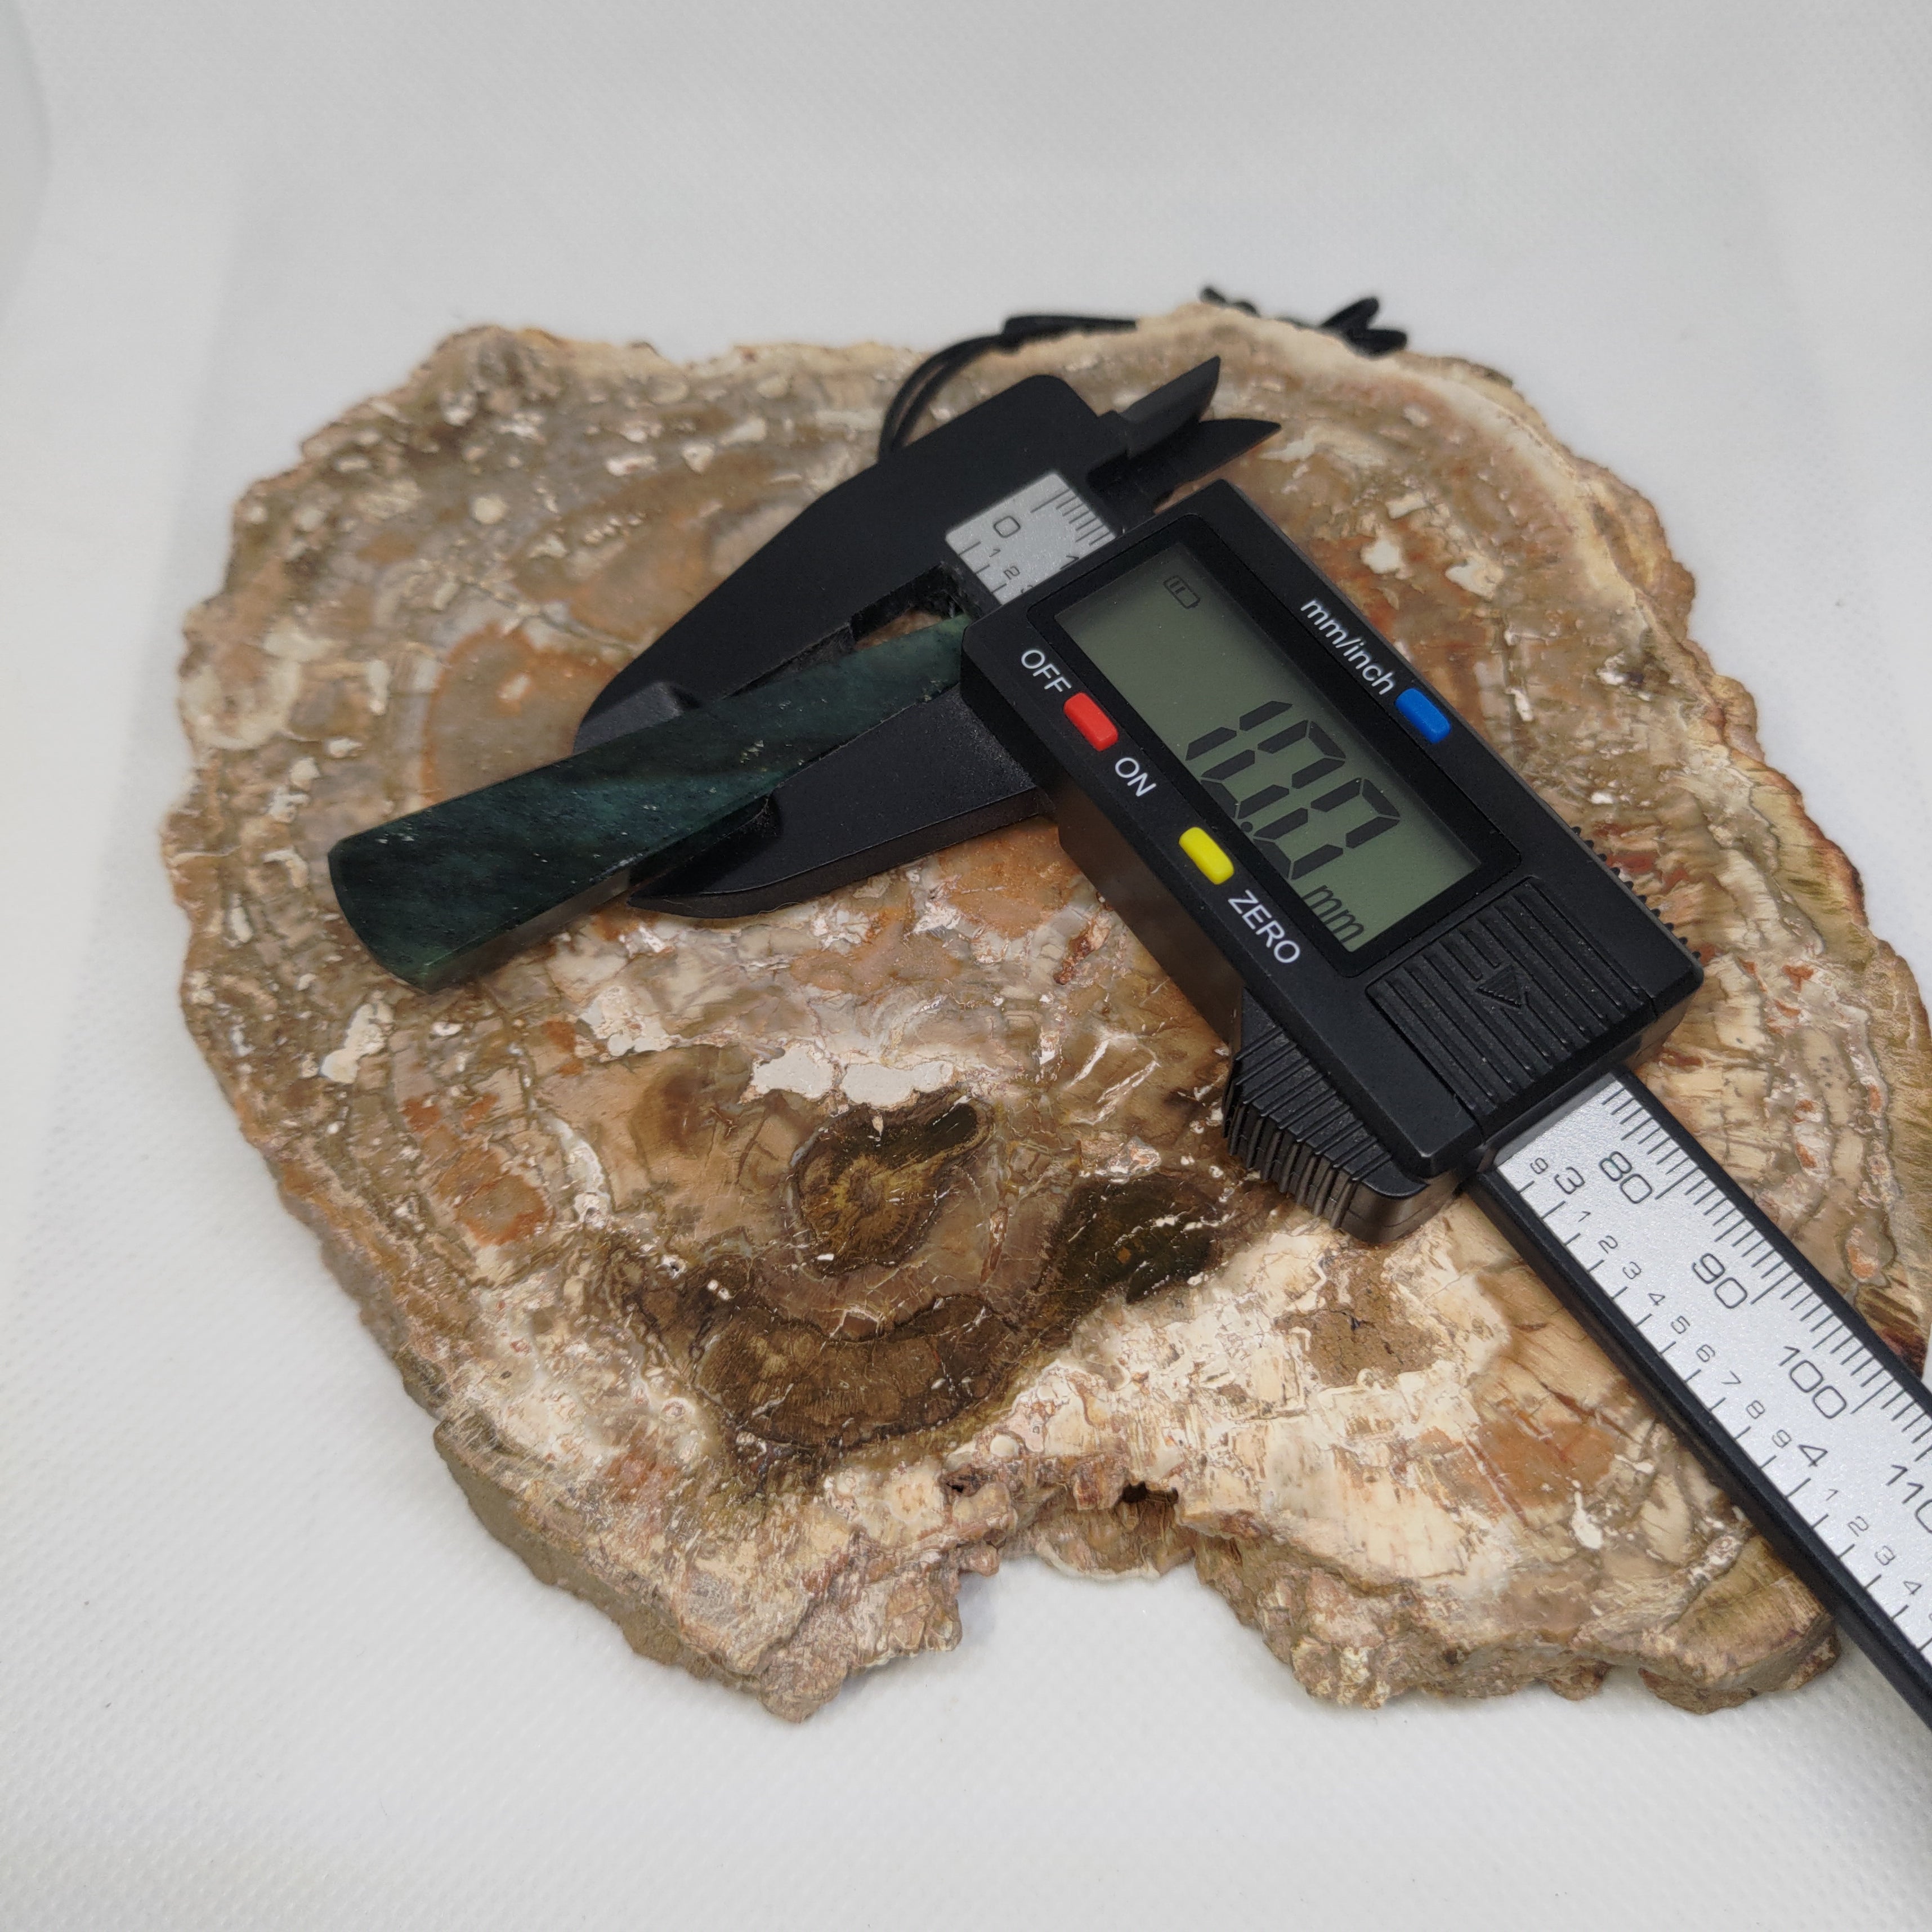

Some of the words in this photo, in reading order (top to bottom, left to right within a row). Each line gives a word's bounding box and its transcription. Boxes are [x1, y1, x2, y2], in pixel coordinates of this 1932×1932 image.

[989, 548, 1001, 558] 1
[1003, 565, 1021, 580] 2
[992, 515, 1021, 539] 0
[1020, 648, 1072, 693] OFF
[1300, 599, 1395, 695] mm/inch
[1115, 757, 1157, 797] ON
[1186, 700, 1401, 880] 10.0
[1304, 884, 1365, 943] mm
[1228, 889, 1300, 964] ZERO
[1598, 1151, 1653, 1205] 80
[1692, 1252, 1748, 1310] 90
[1778, 1345, 1848, 1420] 100
[1530, 1157, 1549, 1175] 9
[1554, 1166, 1586, 1195] 3
[1577, 1210, 1592, 1223] 1
[1598, 1235, 1618, 1254] 2
[1622, 1261, 1642, 1280] 3
[1647, 1293, 1666, 1306] 4
[1670, 1315, 1690, 1335] 5
[1696, 1344, 1716, 1363] 6
[1721, 1370, 1742, 1385] 7
[1746, 1399, 1765, 1420] 8
[1772, 1429, 1792, 1449] 9
[1797, 1444, 1828, 1467] 4
[1825, 1488, 1839, 1504] 1
[1847, 1515, 1870, 1537] 2
[1875, 1545, 1897, 1566] 3
[1902, 1580, 1922, 1595] 4
